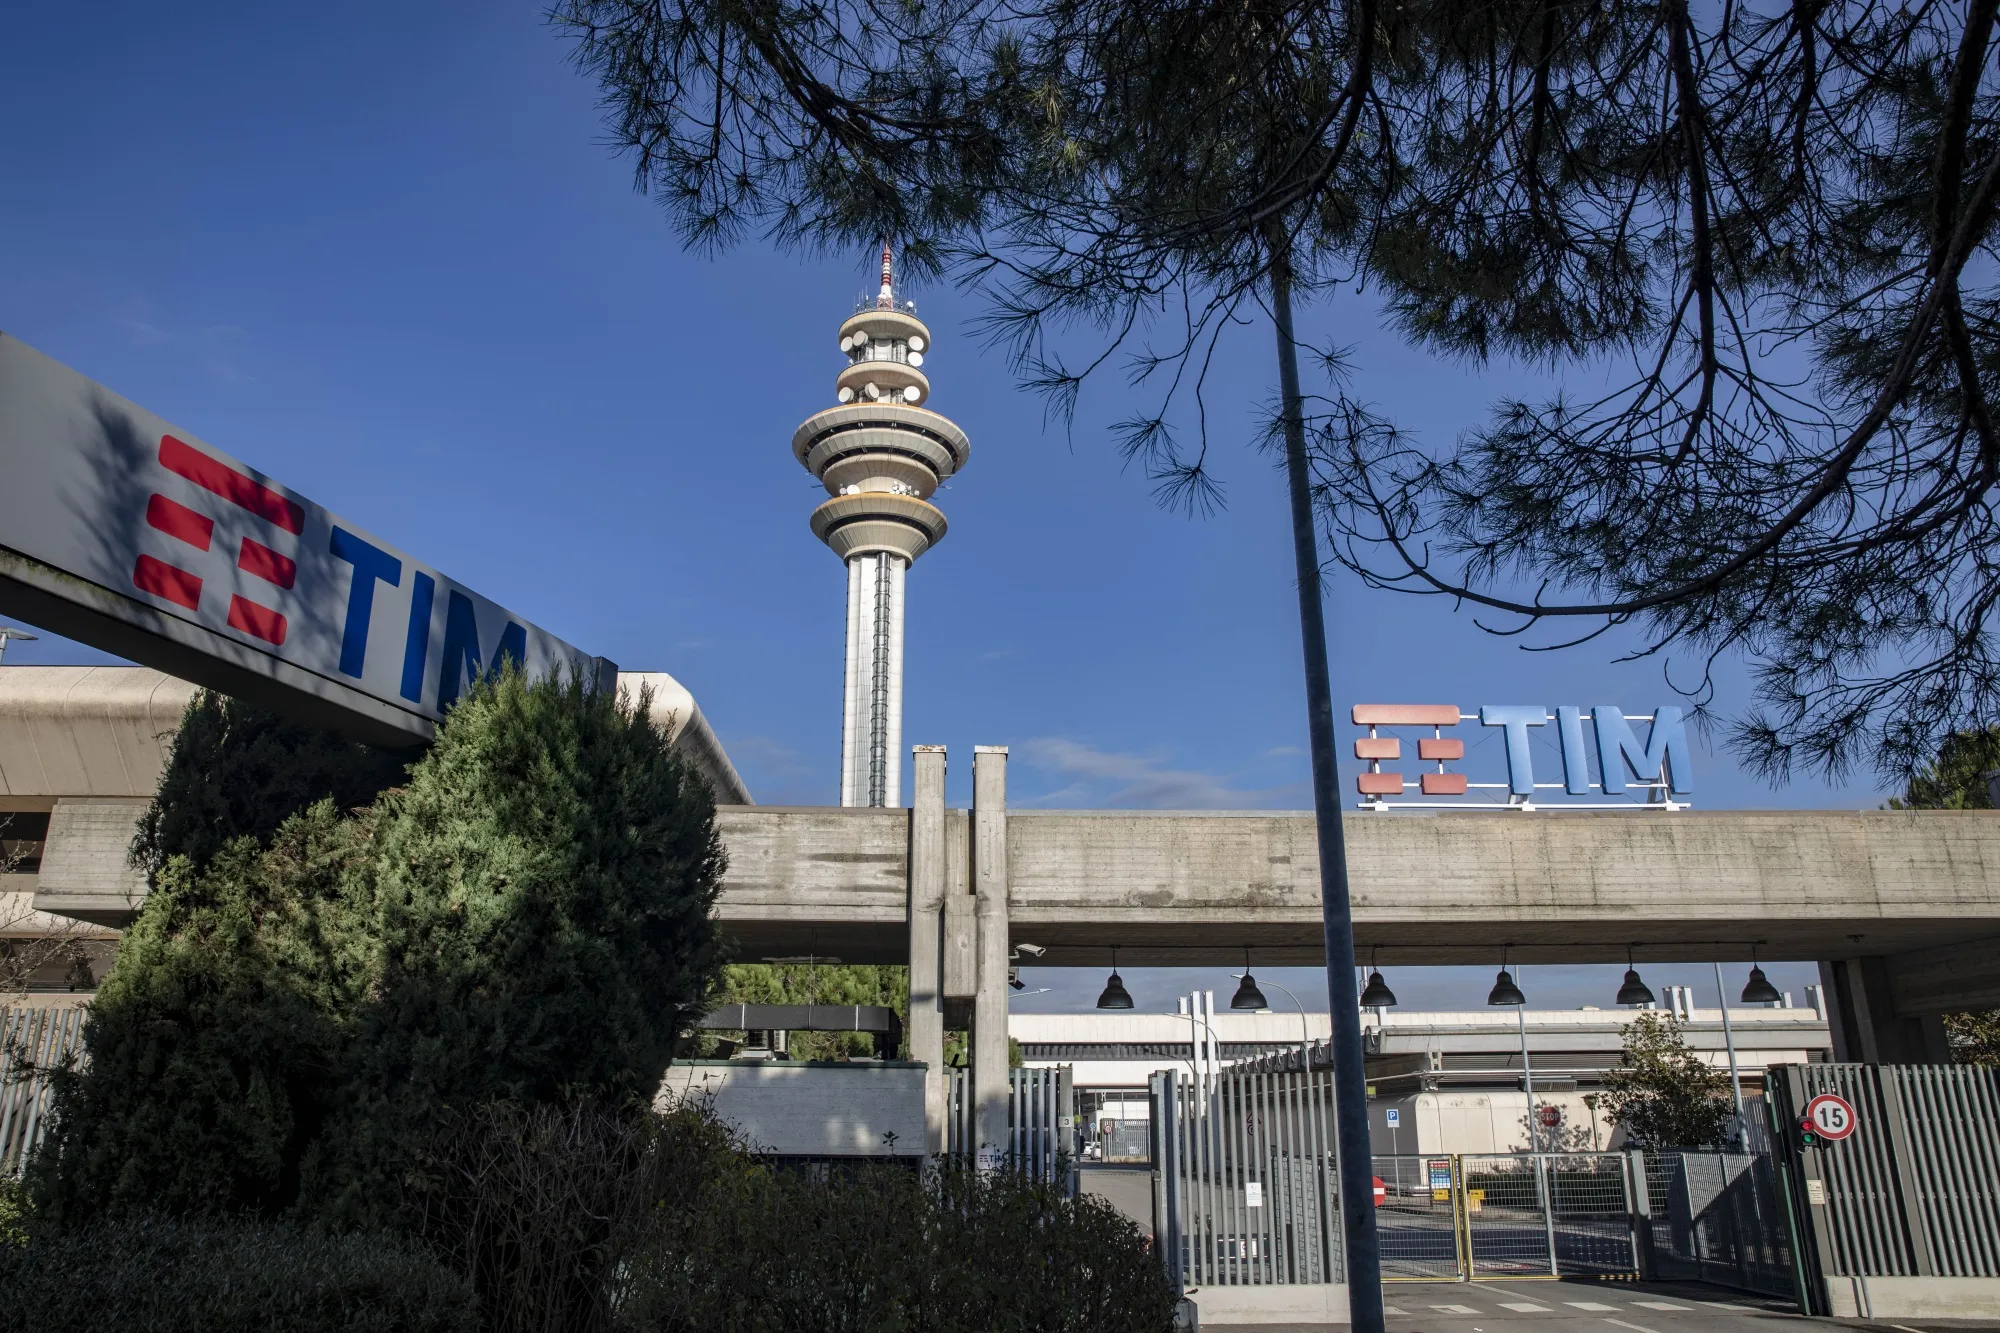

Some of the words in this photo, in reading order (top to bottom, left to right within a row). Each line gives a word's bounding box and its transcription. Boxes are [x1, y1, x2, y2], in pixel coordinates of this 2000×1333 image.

[329, 524, 528, 714] TIM
[1480, 705, 1694, 795] TIM
[1540, 1112, 1559, 1121] STOP
[1820, 1107, 1844, 1128] 15
